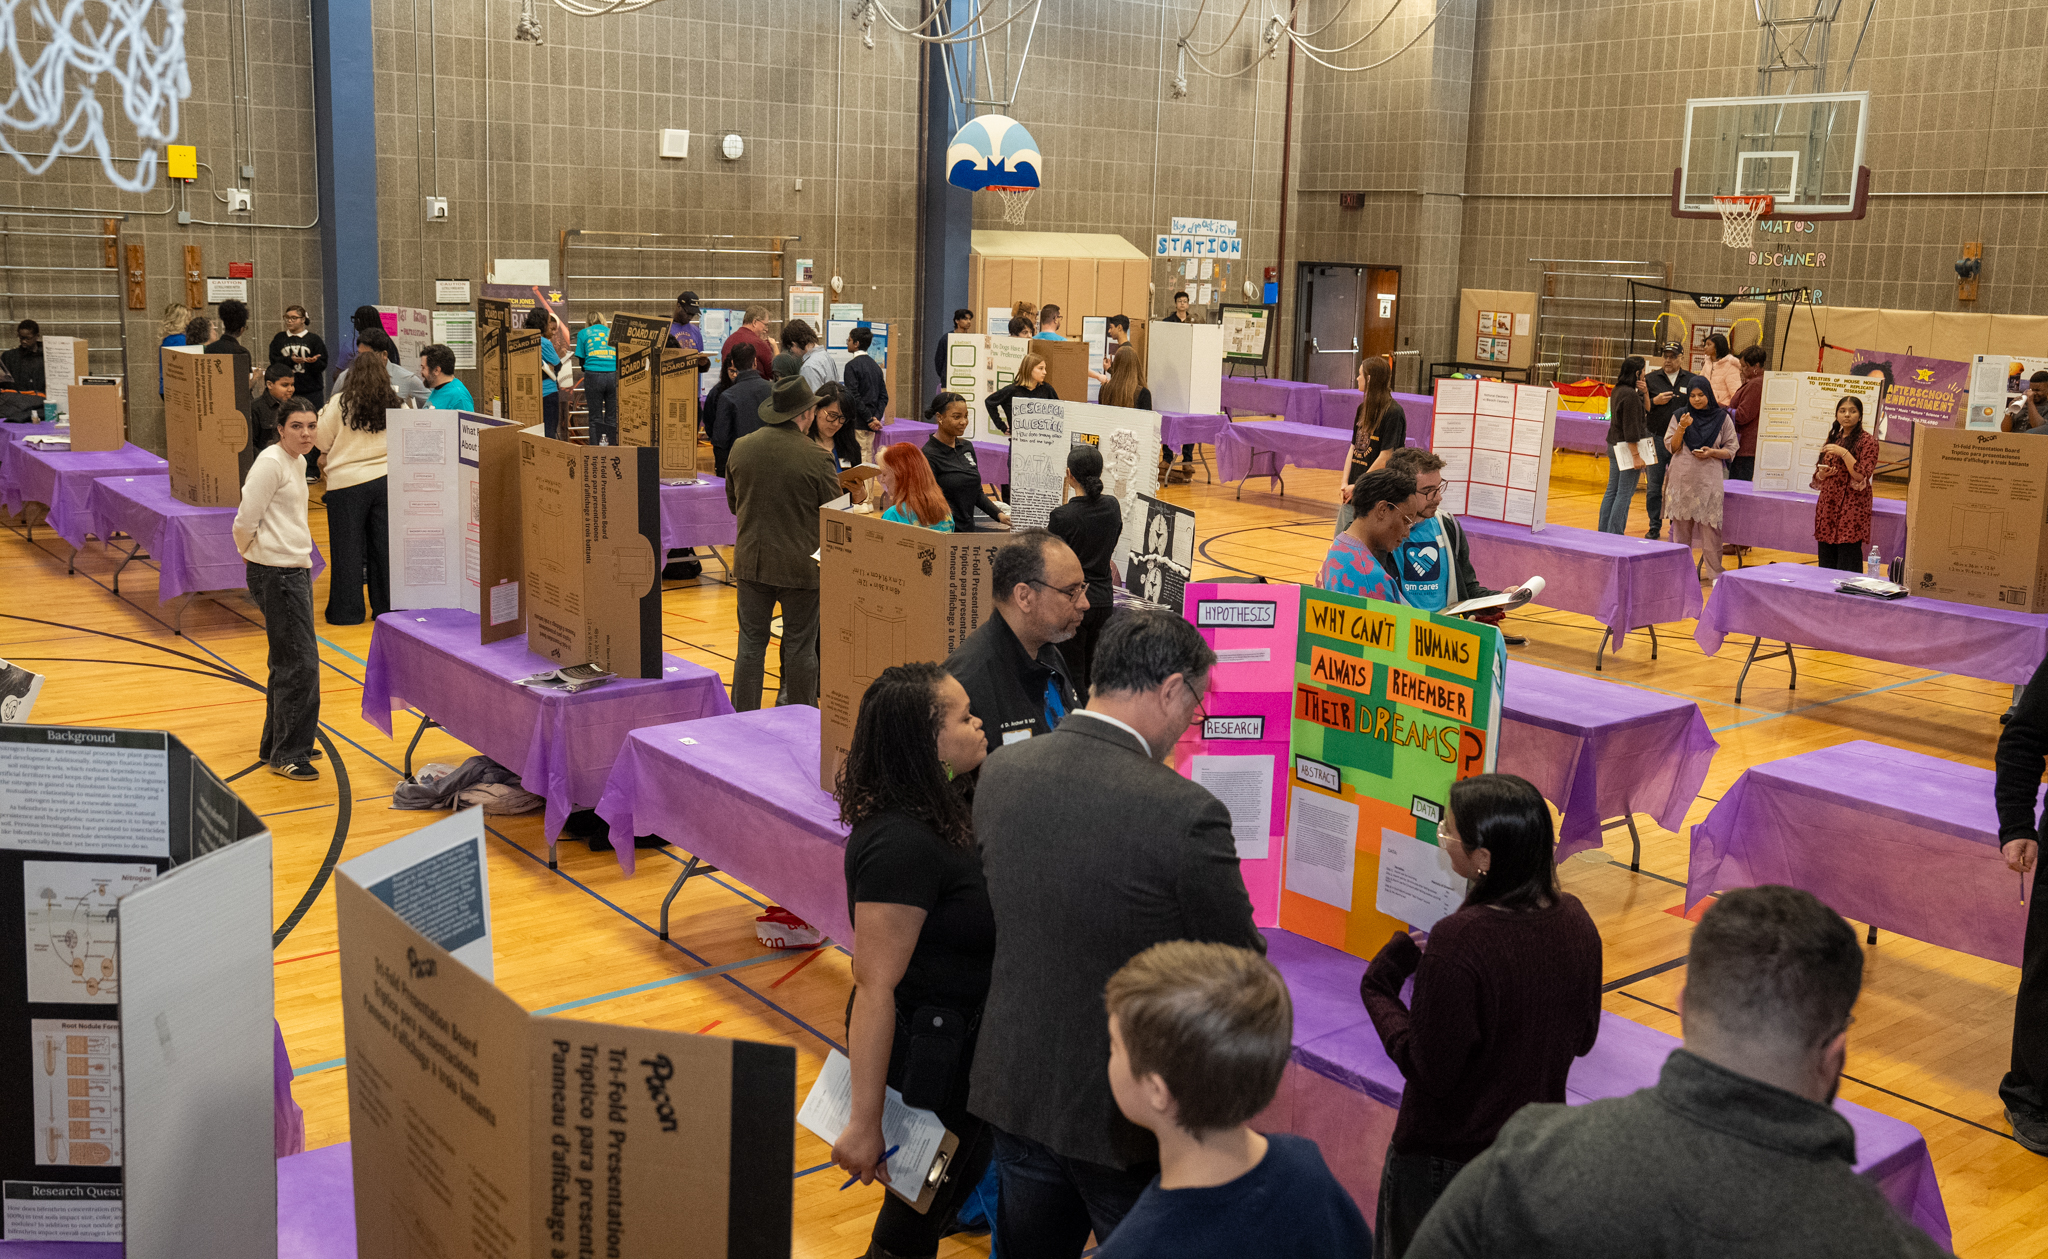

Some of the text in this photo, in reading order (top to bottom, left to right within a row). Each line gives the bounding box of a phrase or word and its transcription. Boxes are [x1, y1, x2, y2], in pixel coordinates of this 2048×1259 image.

[1760, 220, 1815, 234] MATOS
[1158, 237, 1240, 254] STATION
[1748, 251, 1827, 267] DISCHNER
[1700, 296, 1720, 304] SKLZ
[1737, 285, 1823, 305] KILLINGER
[626, 326, 650, 338] BOARD
[648, 330, 659, 340] KIT
[530, 338, 540, 346] KIT
[621, 361, 640, 376] BOARD
[661, 363, 684, 373] BOARD
[632, 371, 646, 383] HEADER
[1818, 381, 1847, 389] EFFECTIVELY
[1887, 384, 1956, 403] AFTERSCHOOL
[1012, 402, 1065, 420] RESEARCH
[1885, 393, 1954, 413] ENRICHMENT
[462, 424, 476, 436] What
[461, 439, 478, 452] About
[1080, 434, 1099, 445] PUFF
[1976, 434, 1998, 444] Pacon
[1971, 444, 2004, 453] Presentation
[1982, 452, 2021, 460] presentaciones
[610, 456, 623, 480] Pacon
[1012, 452, 1055, 475] DATA
[601, 520, 609, 540] Board
[917, 547, 937, 561] Pacon
[949, 545, 958, 580] Panneau
[862, 579, 868, 588] 12
[878, 584, 885, 592] 36
[889, 585, 895, 593] in
[958, 578, 967, 597] para
[971, 545, 981, 630] Tri-Fold Presentation
[1404, 583, 1439, 592] gm cares
[1205, 606, 1271, 622] HYPOTHESIS
[1312, 606, 1470, 664] WHY CAN'T HUMANS
[947, 634, 956, 654] trois
[1314, 654, 1467, 718] ALWAYS REMEMBER
[1297, 684, 1351, 730] THEIR
[1206, 720, 1259, 735] RESEARCH
[47, 730, 116, 744] Background
[1301, 764, 1336, 786] ABSTRACT
[1415, 800, 1437, 820] DATA
[61, 1022, 101, 1031] Root Nodule
[451, 1022, 479, 1057] Board
[552, 1038, 571, 1128] Panneau
[639, 1052, 679, 1133] Pacon
[574, 1124, 594, 1172] para
[32, 1185, 84, 1196] Research
[606, 1129, 627, 1259] Presentation
